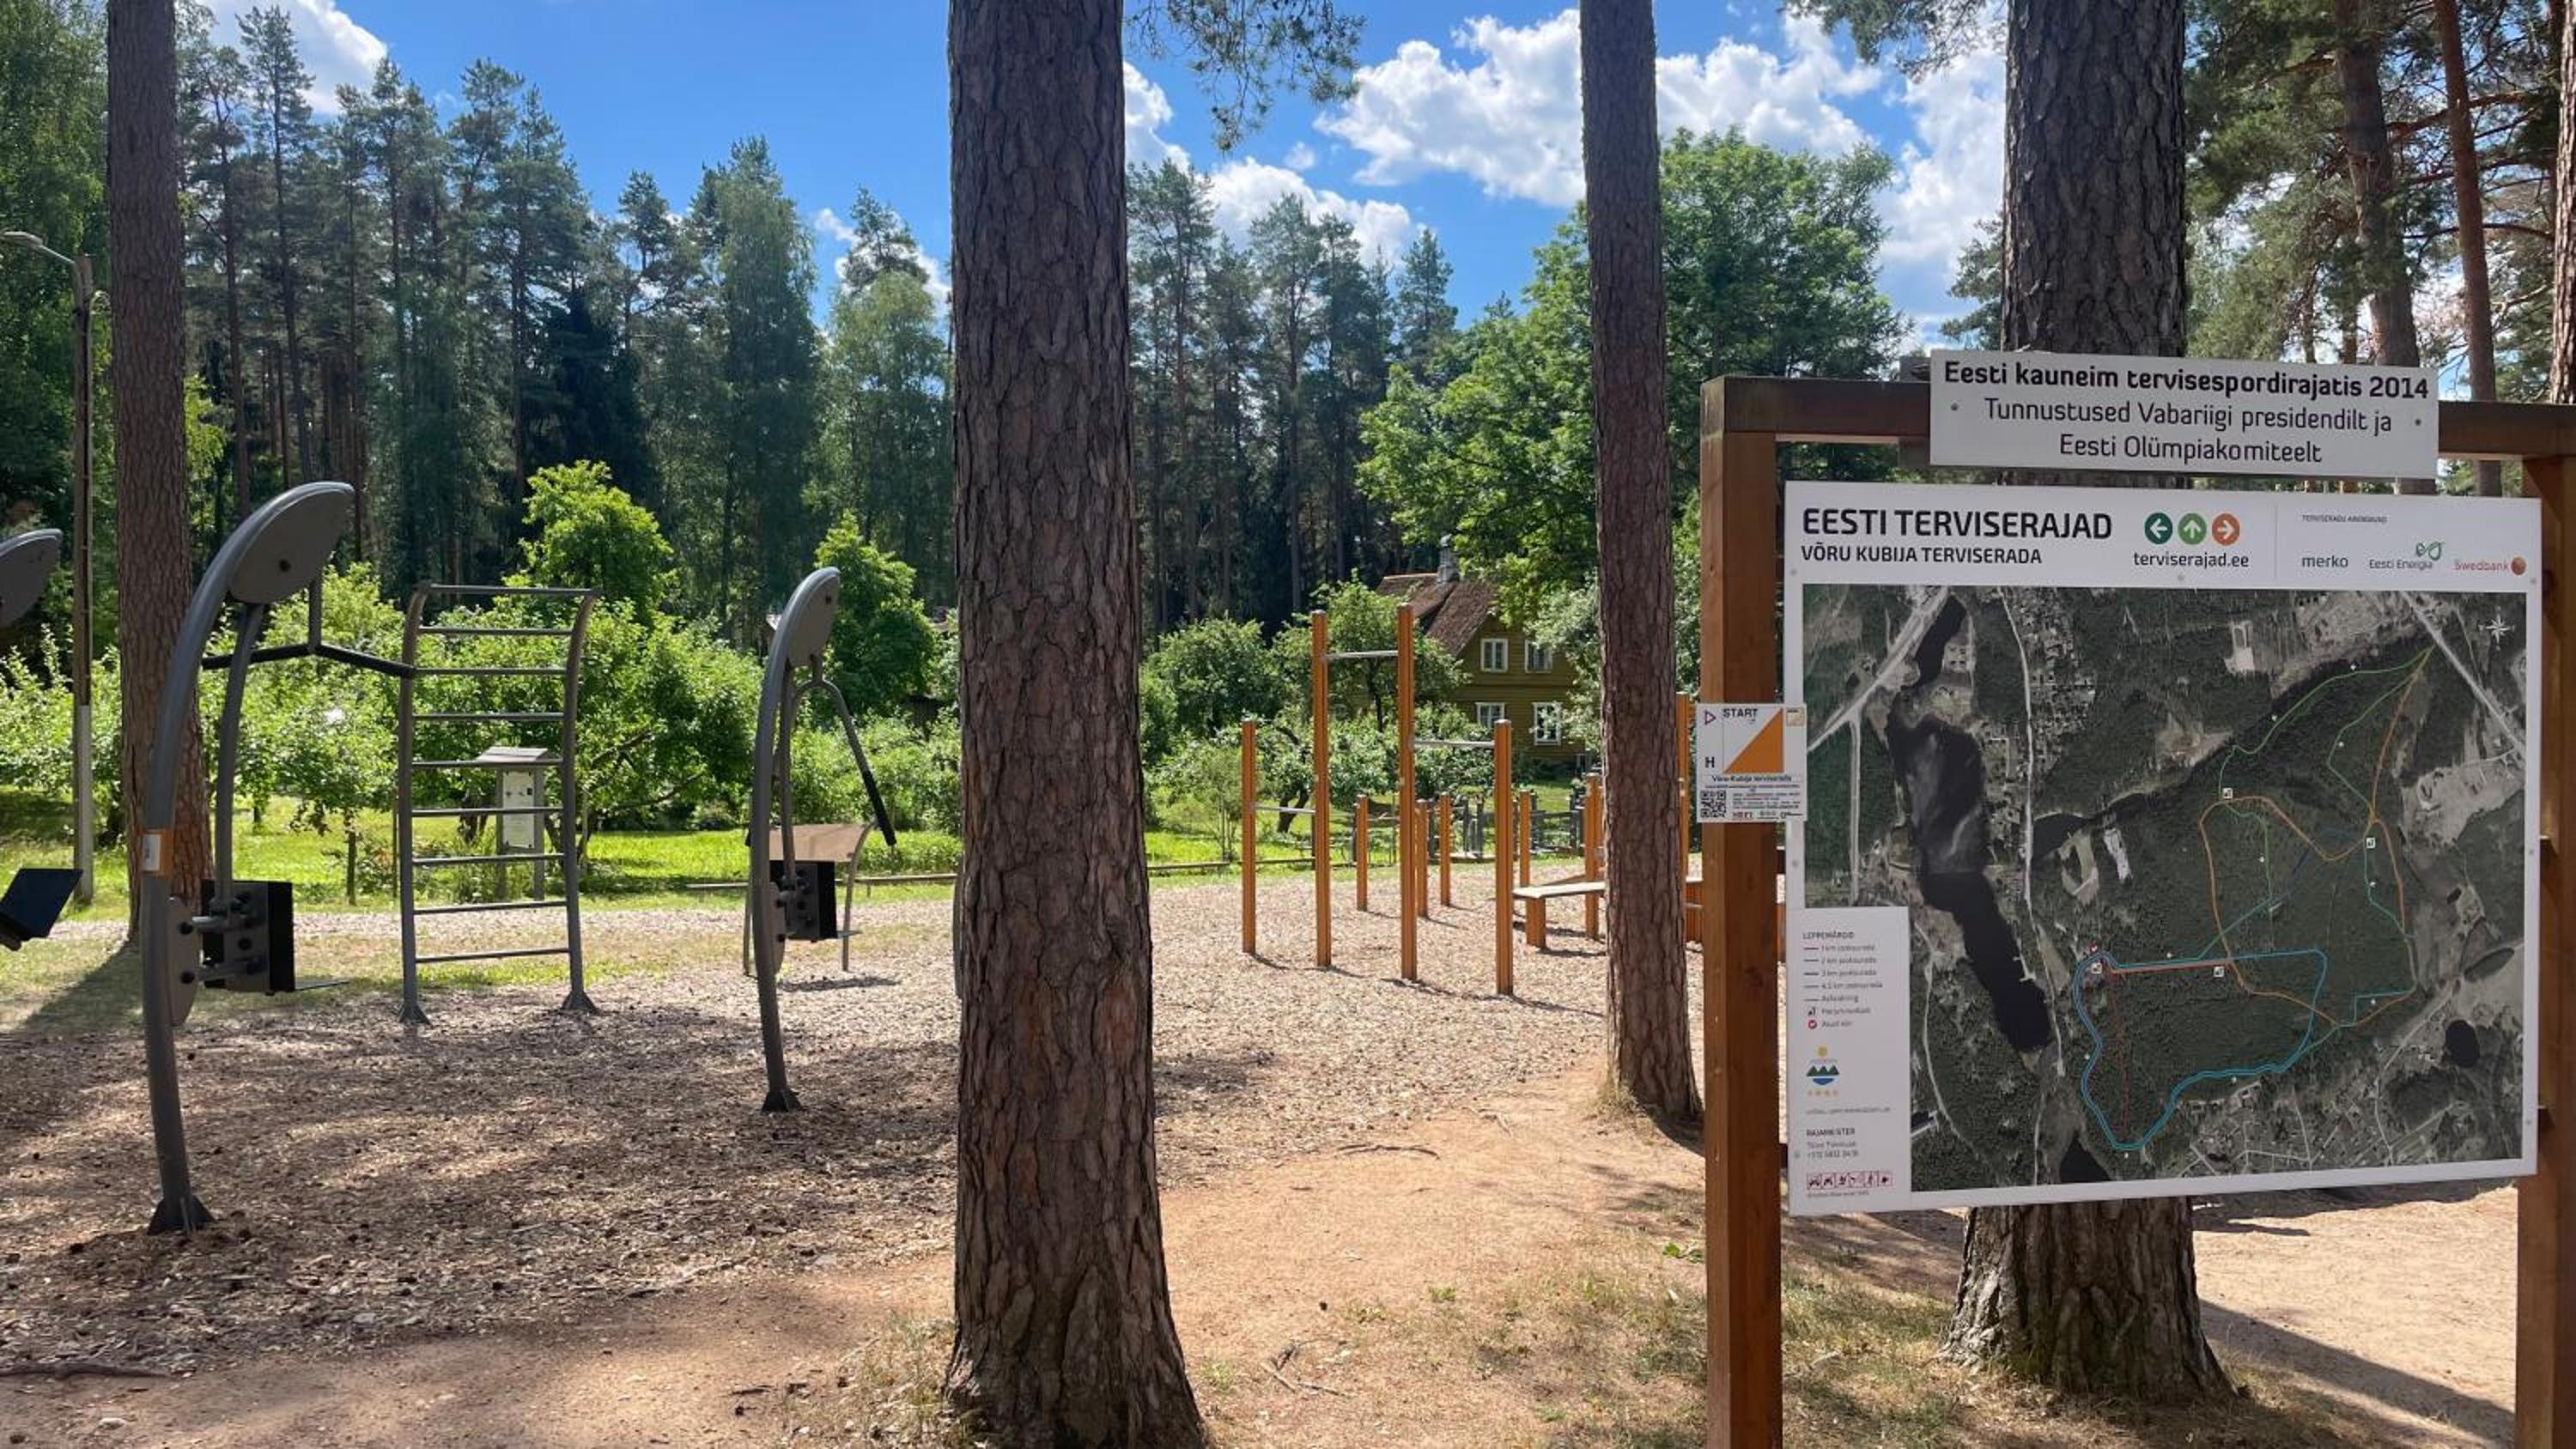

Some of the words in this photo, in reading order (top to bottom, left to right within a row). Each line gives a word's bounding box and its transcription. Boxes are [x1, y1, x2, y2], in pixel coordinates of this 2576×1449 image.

[1944, 361, 2008, 385] Eesti
[2015, 361, 2119, 388] kauneim
[2126, 368, 2362, 401] tervisespordirajatis
[2369, 375, 2429, 399] 2014
[1984, 397, 2131, 423] Tunnustused
[2137, 401, 2233, 432] Vabariigi
[2241, 406, 2368, 433] presidendilt
[2372, 409, 2392, 436] ja
[2060, 433, 2117, 458] Eesti
[2123, 435, 2323, 464] Olümpiakomiteelt
[1802, 507, 1887, 536] EESTI
[1893, 509, 2112, 540] TERVISERAJAD
[1801, 542, 1851, 561] VÕRU
[1856, 545, 1918, 563] KUBIJA
[1920, 546, 2043, 564] TERVISERADA
[2133, 551, 2250, 570] terviserajad.ee
[2301, 555, 2349, 569] merko
[2368, 559, 2395, 569] Eesti
[2396, 559, 2433, 571] Energia
[2454, 559, 2510, 571] Swedbank
[1722, 707, 1759, 718] START
[1704, 756, 1716, 768] H
